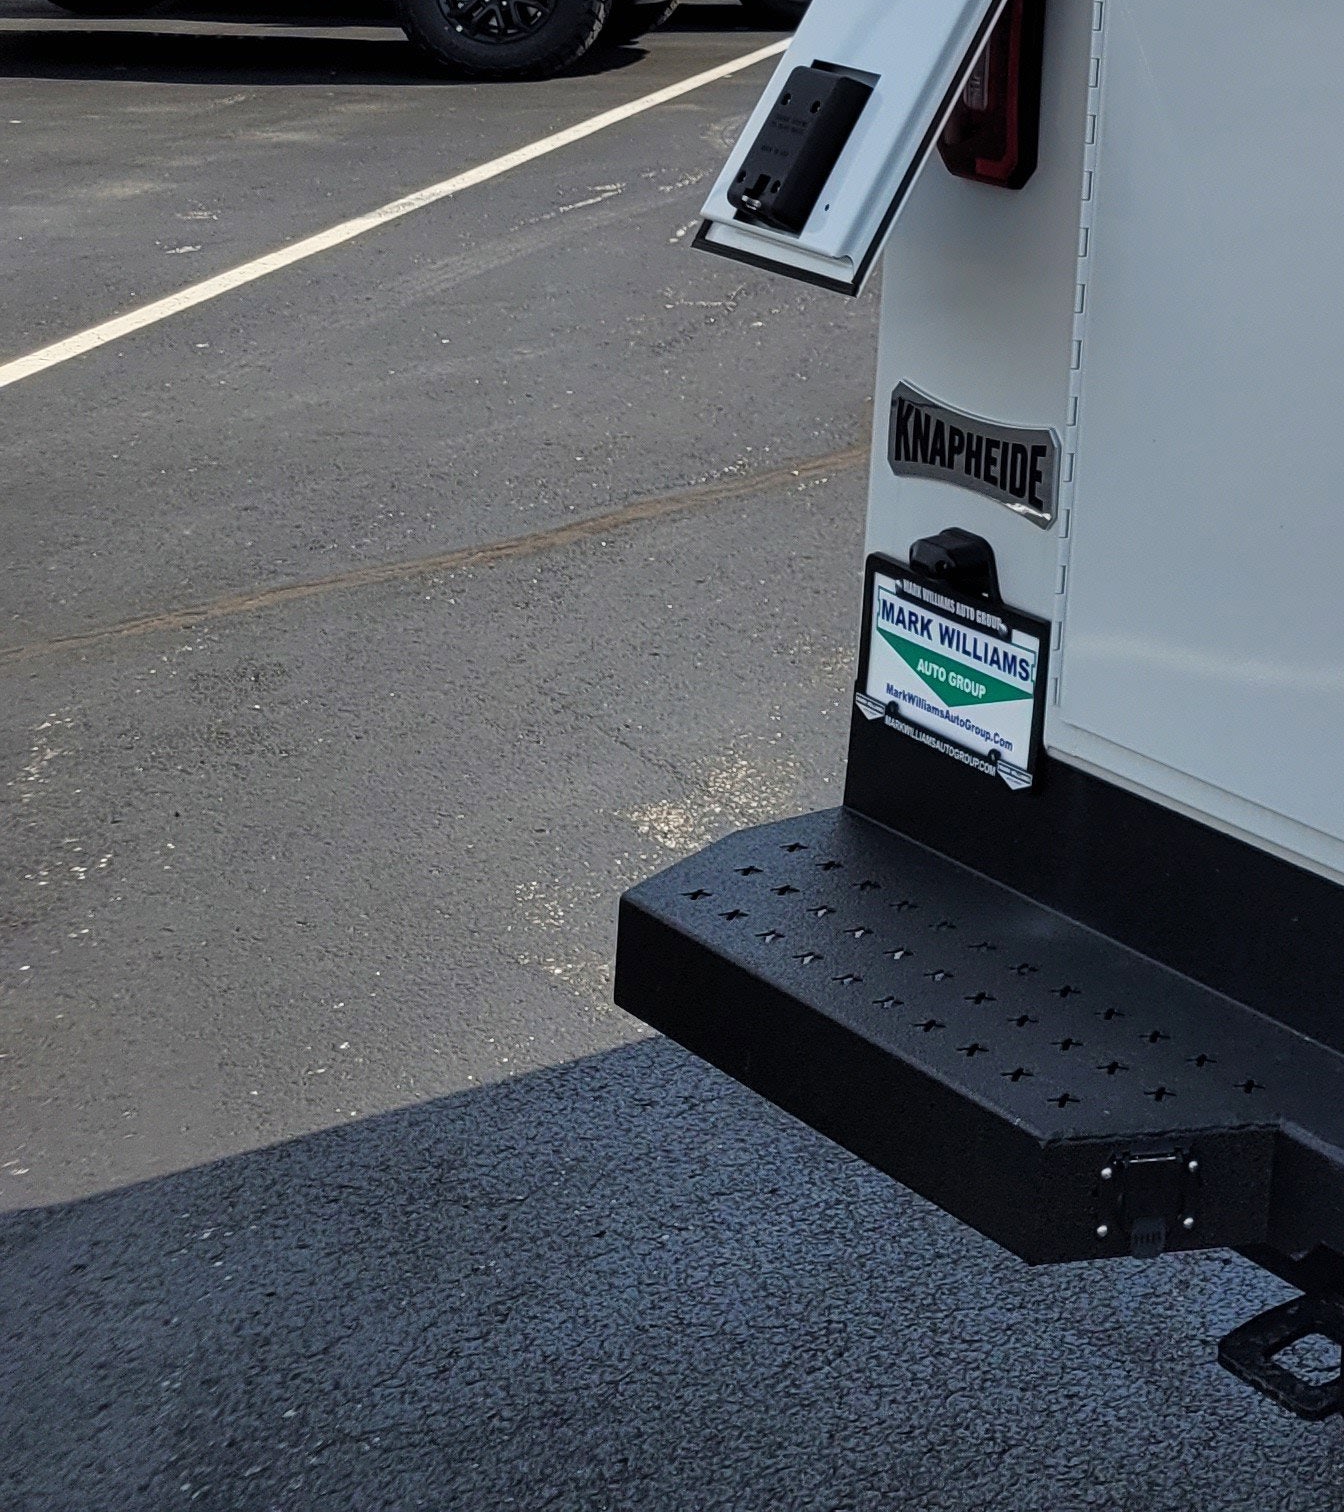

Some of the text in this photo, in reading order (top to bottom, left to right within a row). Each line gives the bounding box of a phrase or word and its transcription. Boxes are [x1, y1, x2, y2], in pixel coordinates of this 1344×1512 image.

[894, 397, 1047, 509] KNAPHEIDE
[902, 578, 922, 596] MARK
[921, 587, 956, 614] WILLIAMS
[955, 601, 975, 621] AUTO
[881, 598, 1031, 682] MARK WILLIAMS
[916, 658, 987, 699] AUTO GROUP
[884, 715, 997, 777] MARKWILLIAMSAUTOGROUP.COM
[885, 682, 1014, 752] MarkWilliamsAutoGroup.Com
